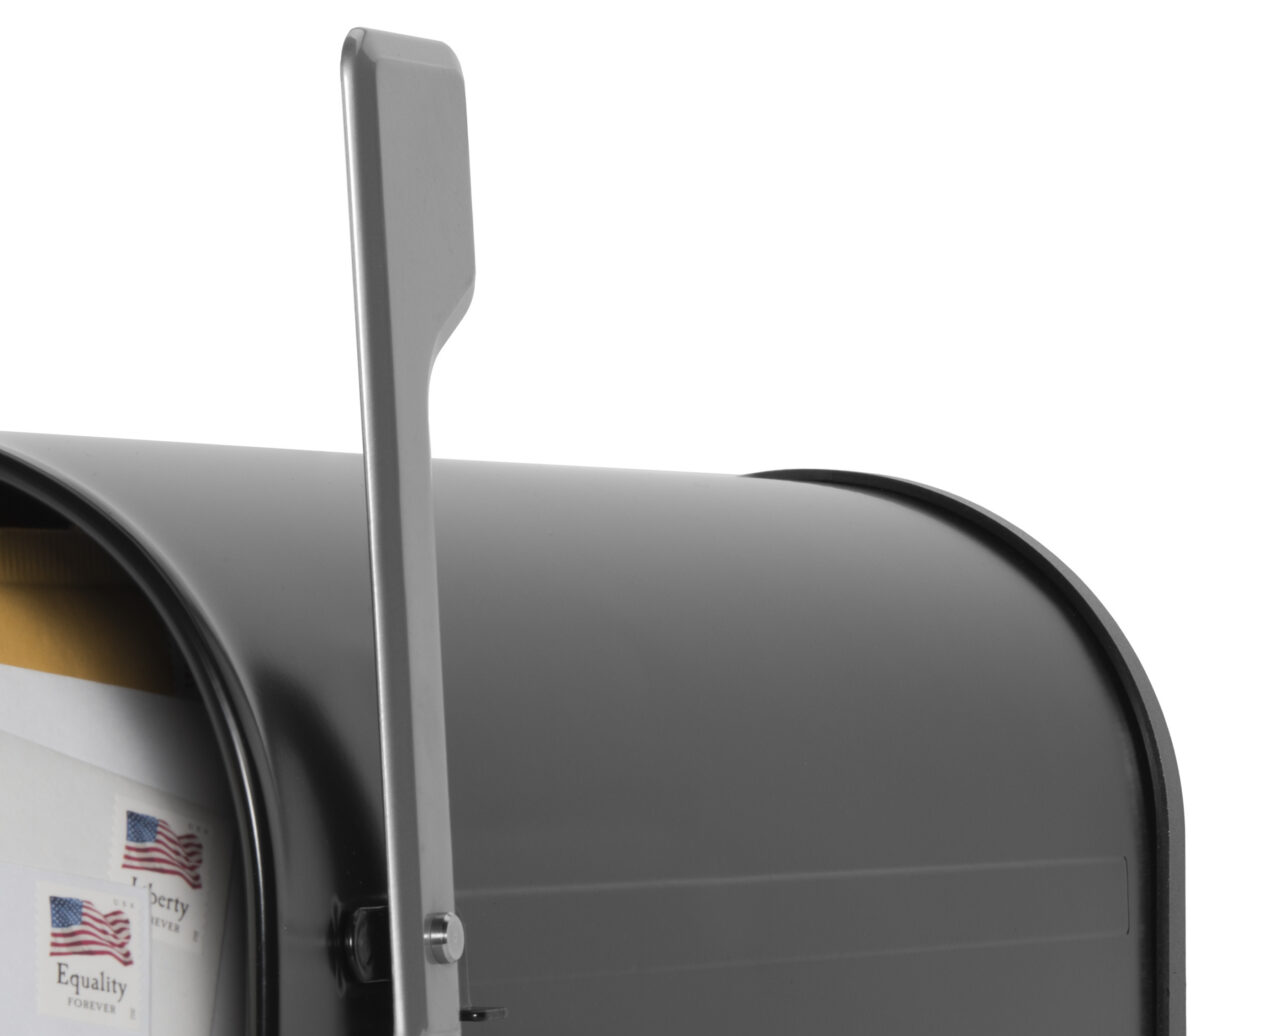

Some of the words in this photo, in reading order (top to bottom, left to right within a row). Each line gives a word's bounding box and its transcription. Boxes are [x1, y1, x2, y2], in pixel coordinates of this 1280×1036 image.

[132, 876, 190, 922] berty
[56, 962, 127, 1003] Equality
[67, 997, 117, 1014] FOREVER
